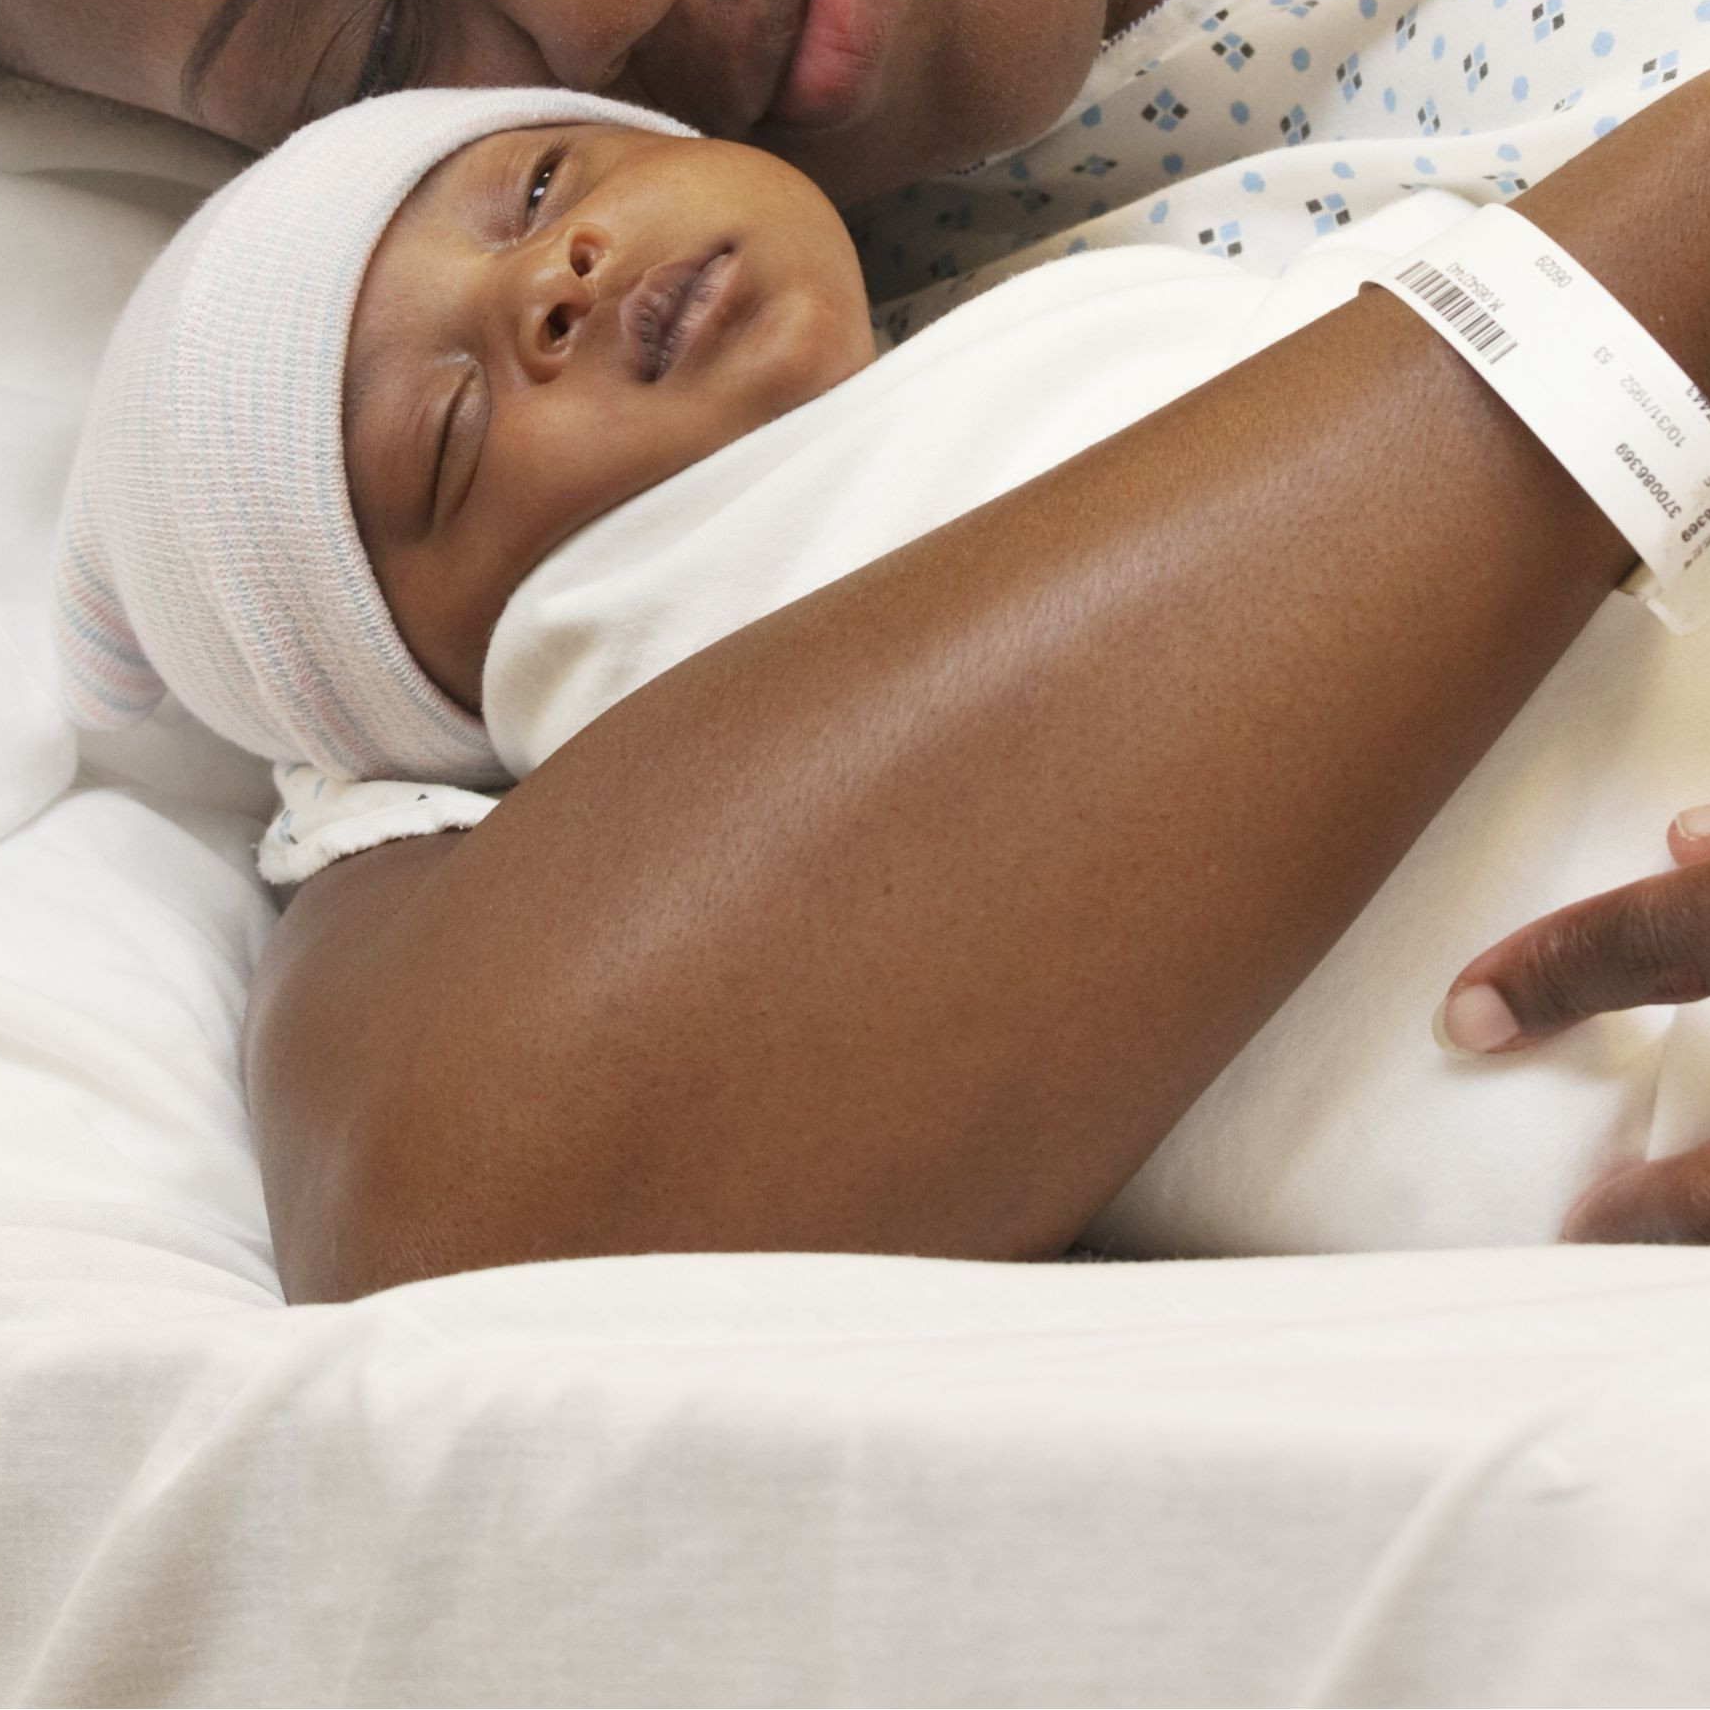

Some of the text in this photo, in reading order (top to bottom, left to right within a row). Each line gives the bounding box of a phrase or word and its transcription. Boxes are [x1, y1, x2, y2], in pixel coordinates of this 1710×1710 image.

[1534, 255, 1574, 289] 06029
[1593, 346, 1687, 448] 10/31/1952 53
[1615, 443, 1682, 519] 370086369
